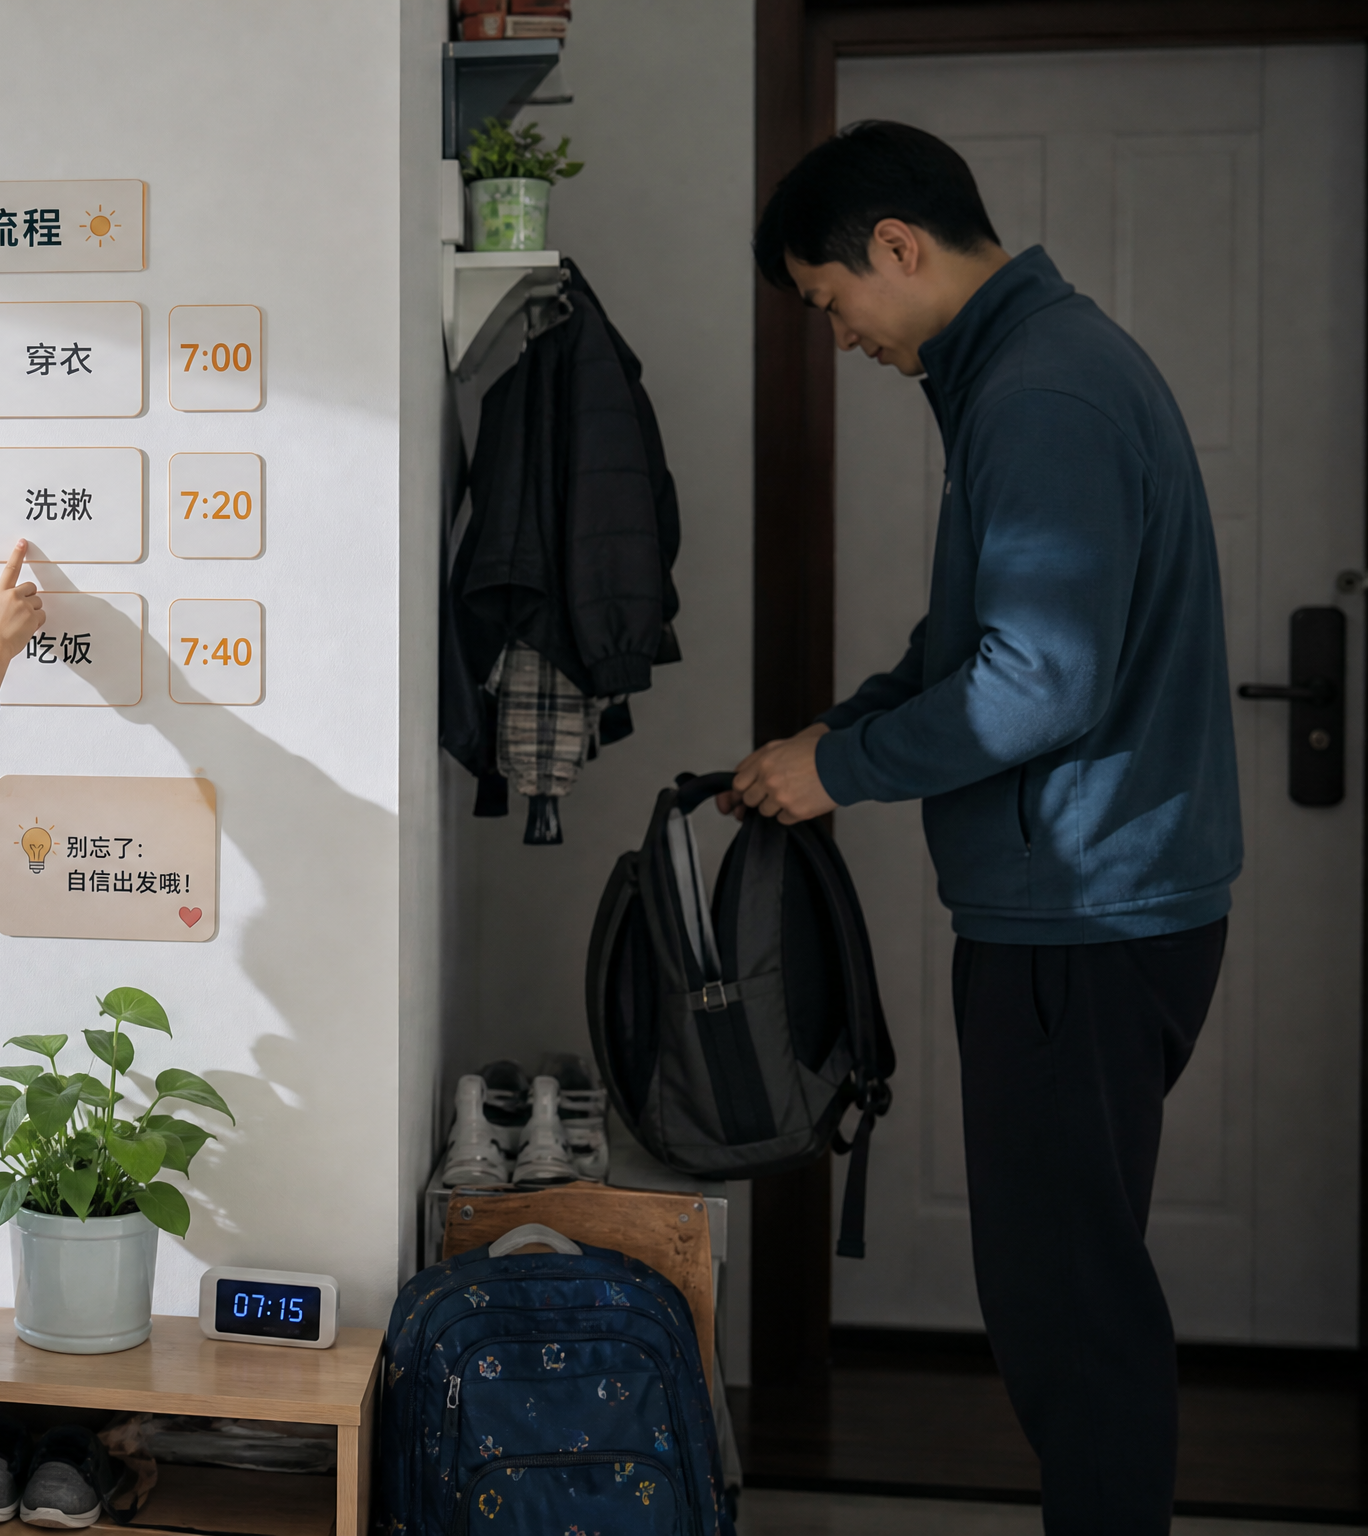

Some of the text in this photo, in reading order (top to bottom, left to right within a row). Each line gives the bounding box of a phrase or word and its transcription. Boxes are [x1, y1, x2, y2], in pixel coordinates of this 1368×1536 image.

[26, 342, 93, 376] 穿衣
[180, 343, 252, 372] 7:00
[25, 488, 93, 521] 洗漱
[180, 491, 252, 520] 7:20
[27, 632, 93, 664] 吃饭
[180, 638, 252, 667] 7:40
[67, 836, 143, 860] 别忘了:
[68, 869, 190, 894] 自信出发哦!
[233, 1293, 303, 1322] 07:15
